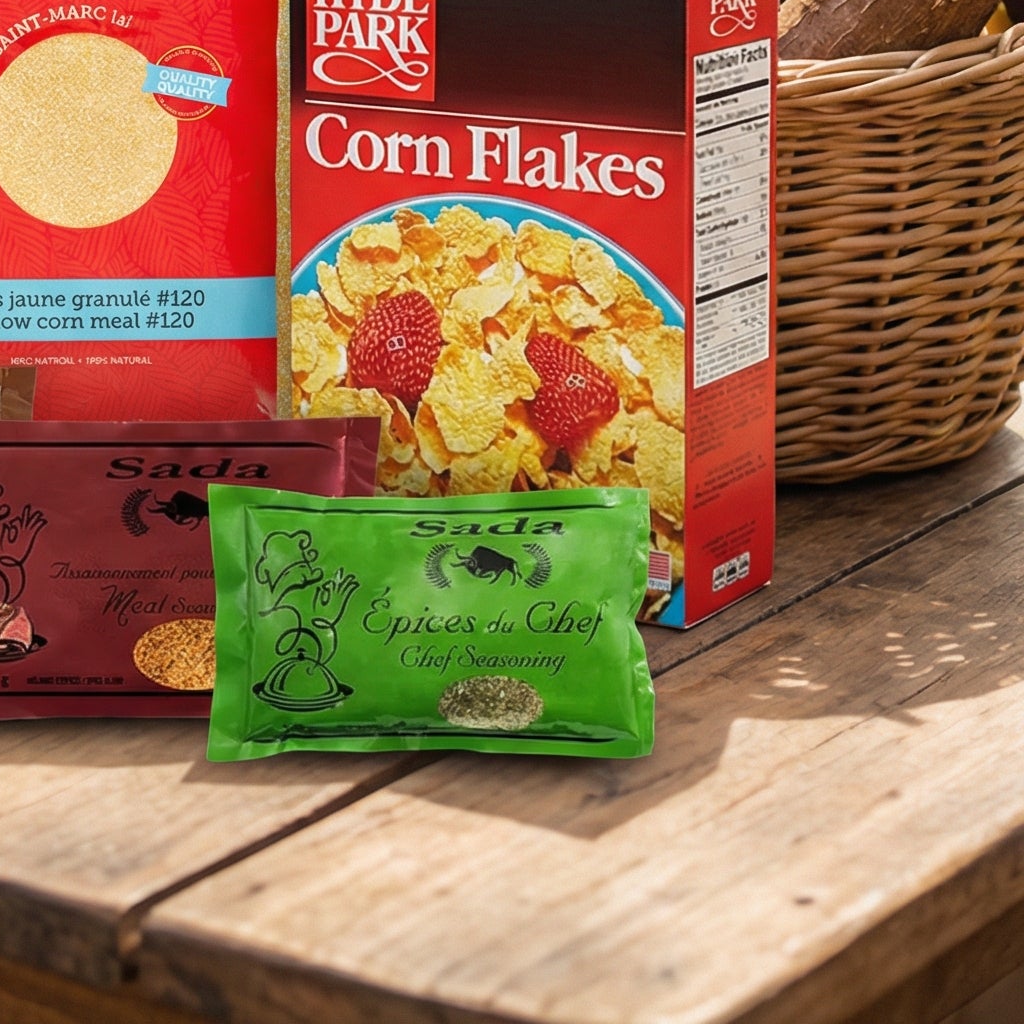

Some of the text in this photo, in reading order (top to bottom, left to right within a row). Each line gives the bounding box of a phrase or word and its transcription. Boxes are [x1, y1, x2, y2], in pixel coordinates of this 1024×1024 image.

[312, 10, 429, 76] PARK
[741, 45, 768, 64] Facts
[305, 112, 666, 200] Corn Flakes
[8, 291, 66, 311] jaune
[72, 290, 151, 310] granulé
[156, 290, 205, 307] #120
[36, 316, 83, 329] corn
[90, 313, 140, 329] meal
[146, 312, 195, 329] #120
[106, 456, 270, 479] Sada
[410, 516, 565, 537] Sada
[363, 587, 609, 646] Épices du Chef
[400, 645, 566, 676] Chef Seasoning
